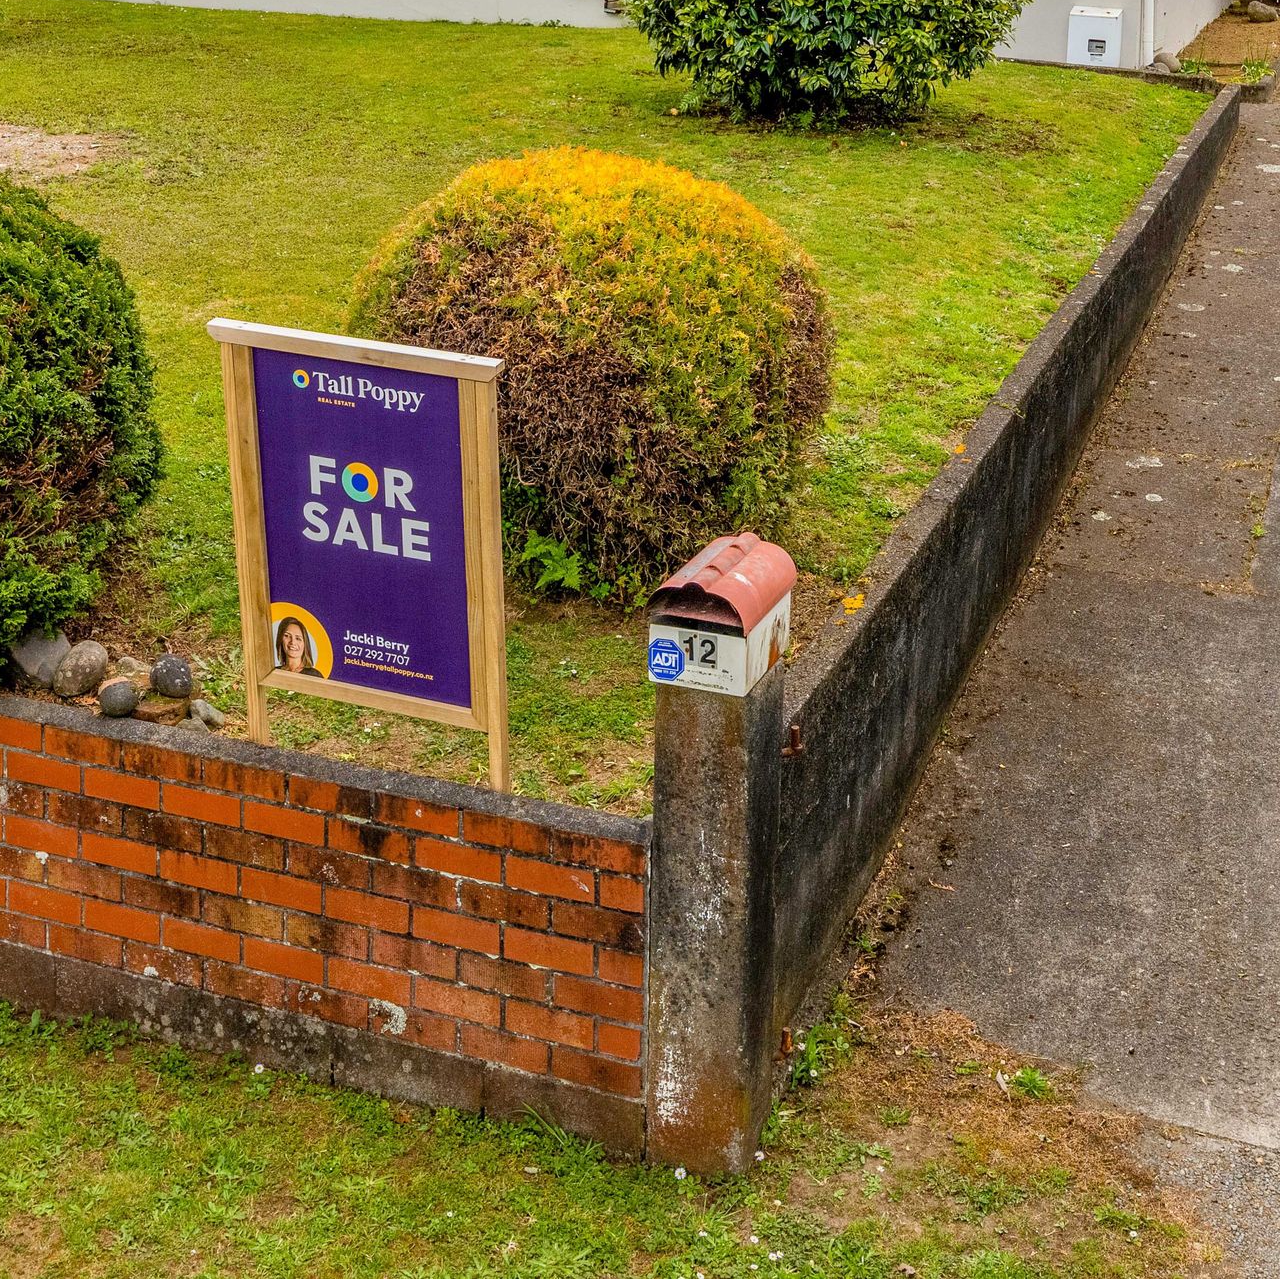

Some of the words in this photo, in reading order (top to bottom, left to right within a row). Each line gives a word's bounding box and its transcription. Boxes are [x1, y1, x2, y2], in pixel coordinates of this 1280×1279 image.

[312, 371, 354, 397] Tall
[357, 378, 425, 412] Poppy
[317, 397, 333, 405] REAL
[334, 398, 356, 408] ESTATE
[309, 454, 417, 512] FOR
[302, 501, 431, 562] SALE
[343, 630, 374, 645] Jacki
[376, 636, 410, 654] Berry
[683, 636, 716, 664] 12
[344, 644, 363, 656] 027
[365, 649, 384, 661] 292
[385, 652, 410, 666] 7707
[653, 652, 678, 667] ADT
[343, 656, 434, 680] jacki.berry@tallpoppy.co.nz
